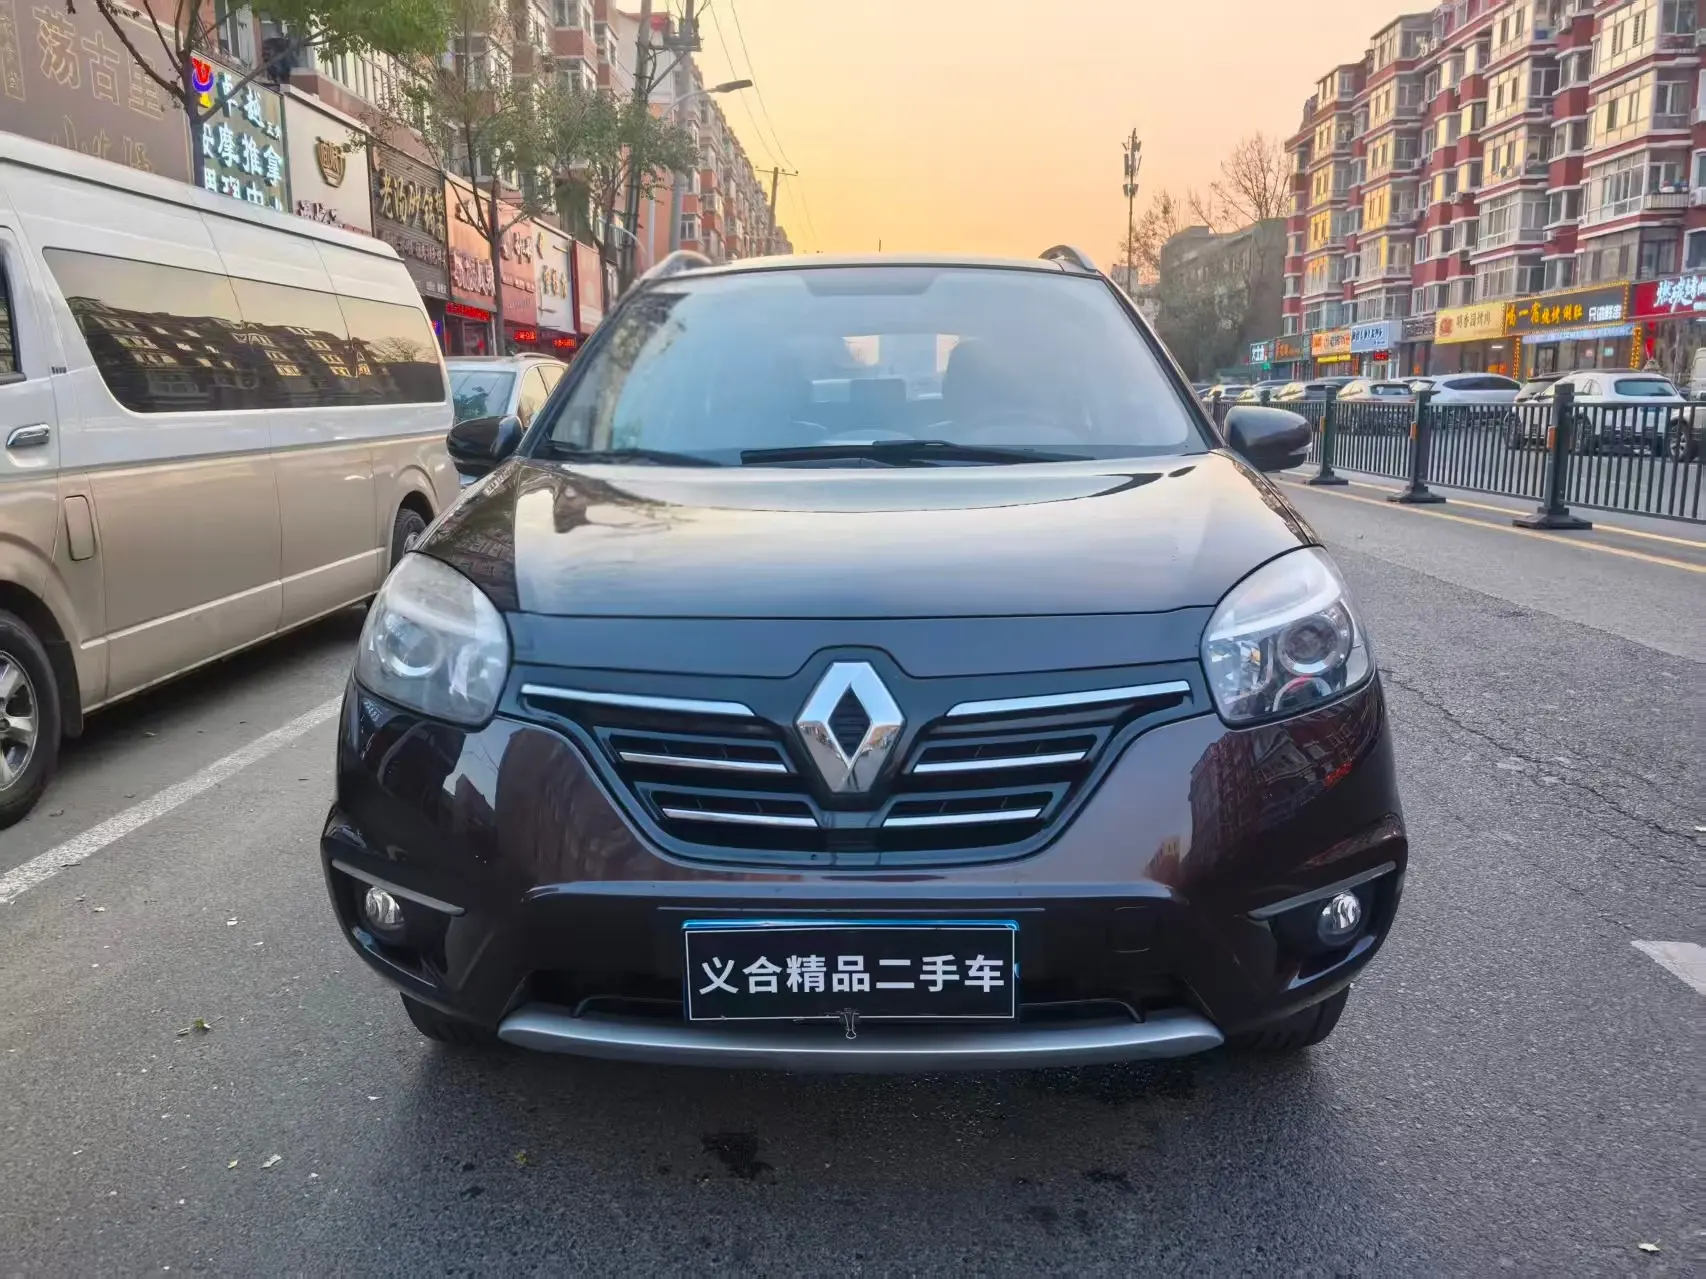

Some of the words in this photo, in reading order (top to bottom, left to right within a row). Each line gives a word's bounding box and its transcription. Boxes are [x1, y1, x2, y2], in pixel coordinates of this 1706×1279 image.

[699, 954, 1005, 995] 义合精品二手车
